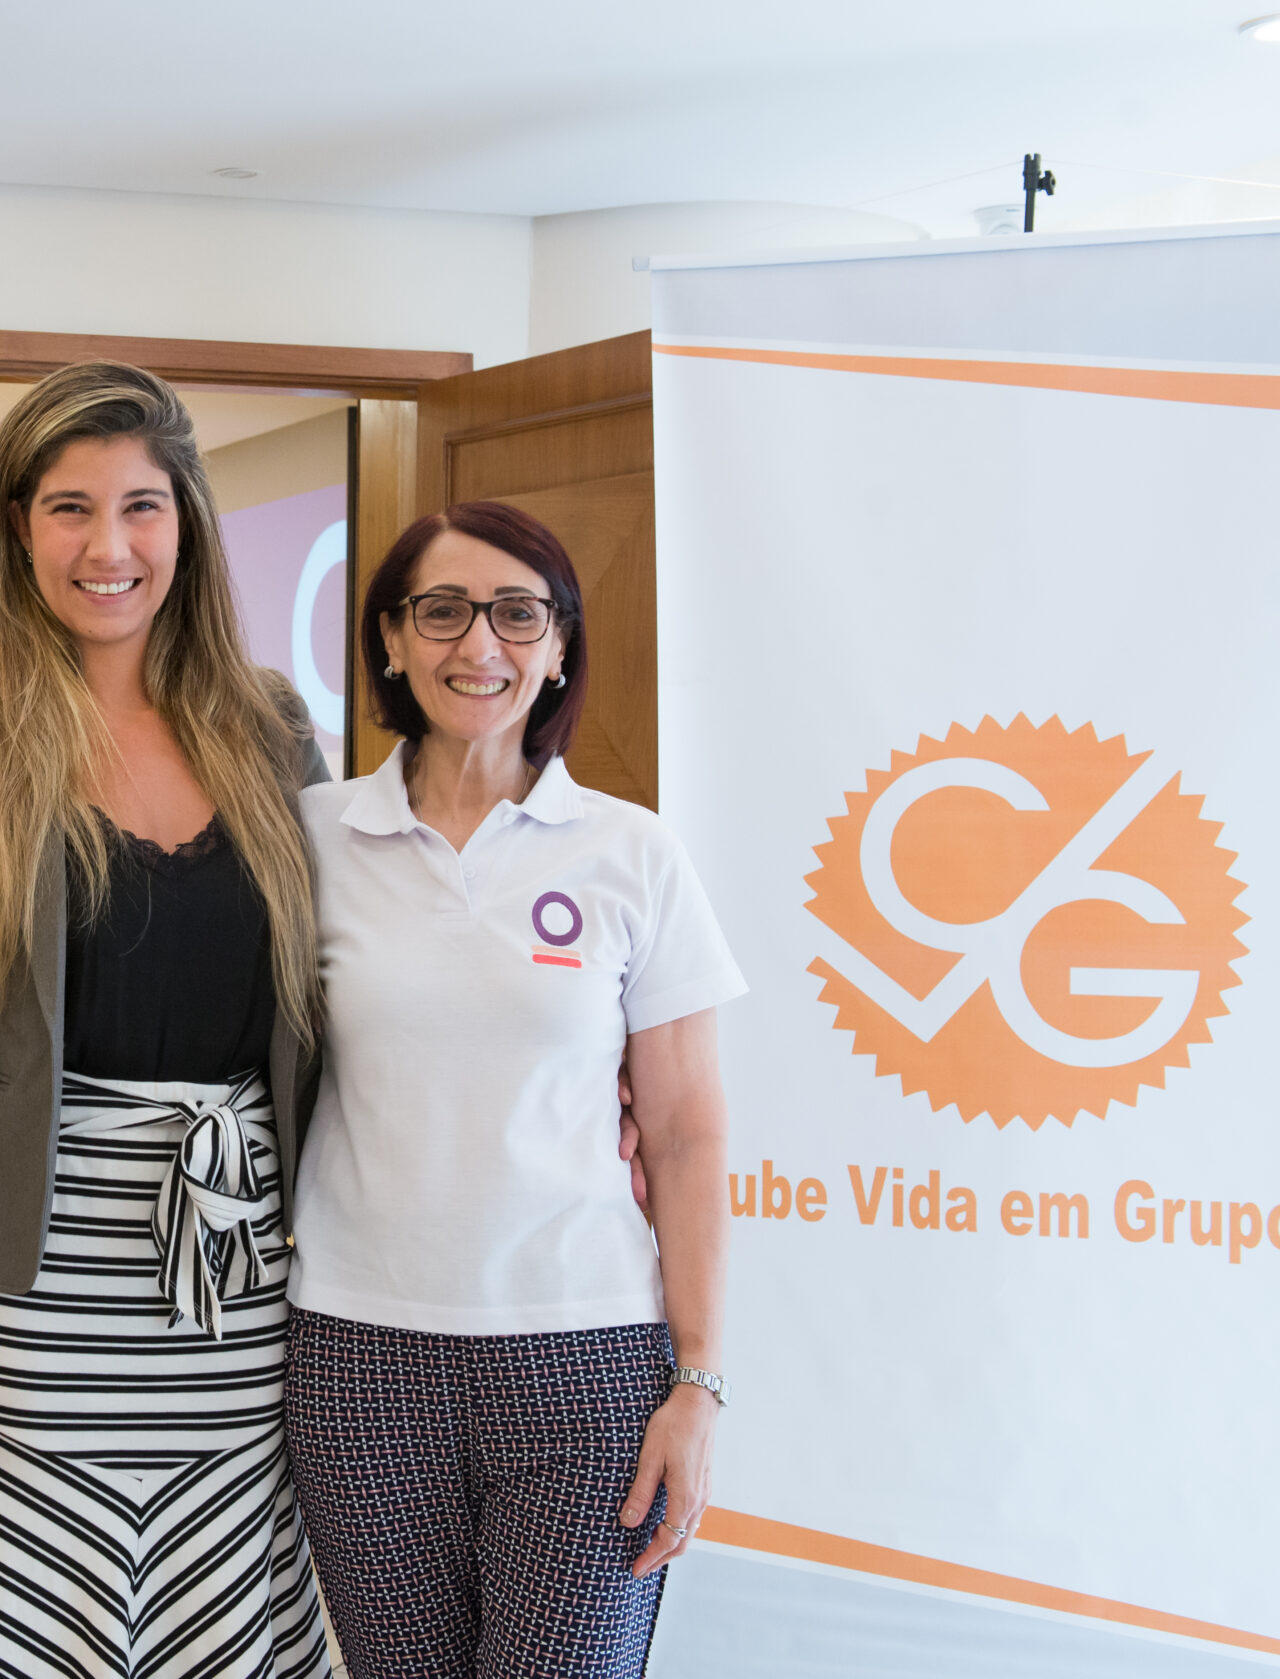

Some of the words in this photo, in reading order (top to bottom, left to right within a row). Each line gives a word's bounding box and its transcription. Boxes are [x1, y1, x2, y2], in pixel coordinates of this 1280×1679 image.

[728, 1159, 827, 1222] ube
[847, 1164, 978, 1232] Vida
[1000, 1189, 1089, 1239] em
